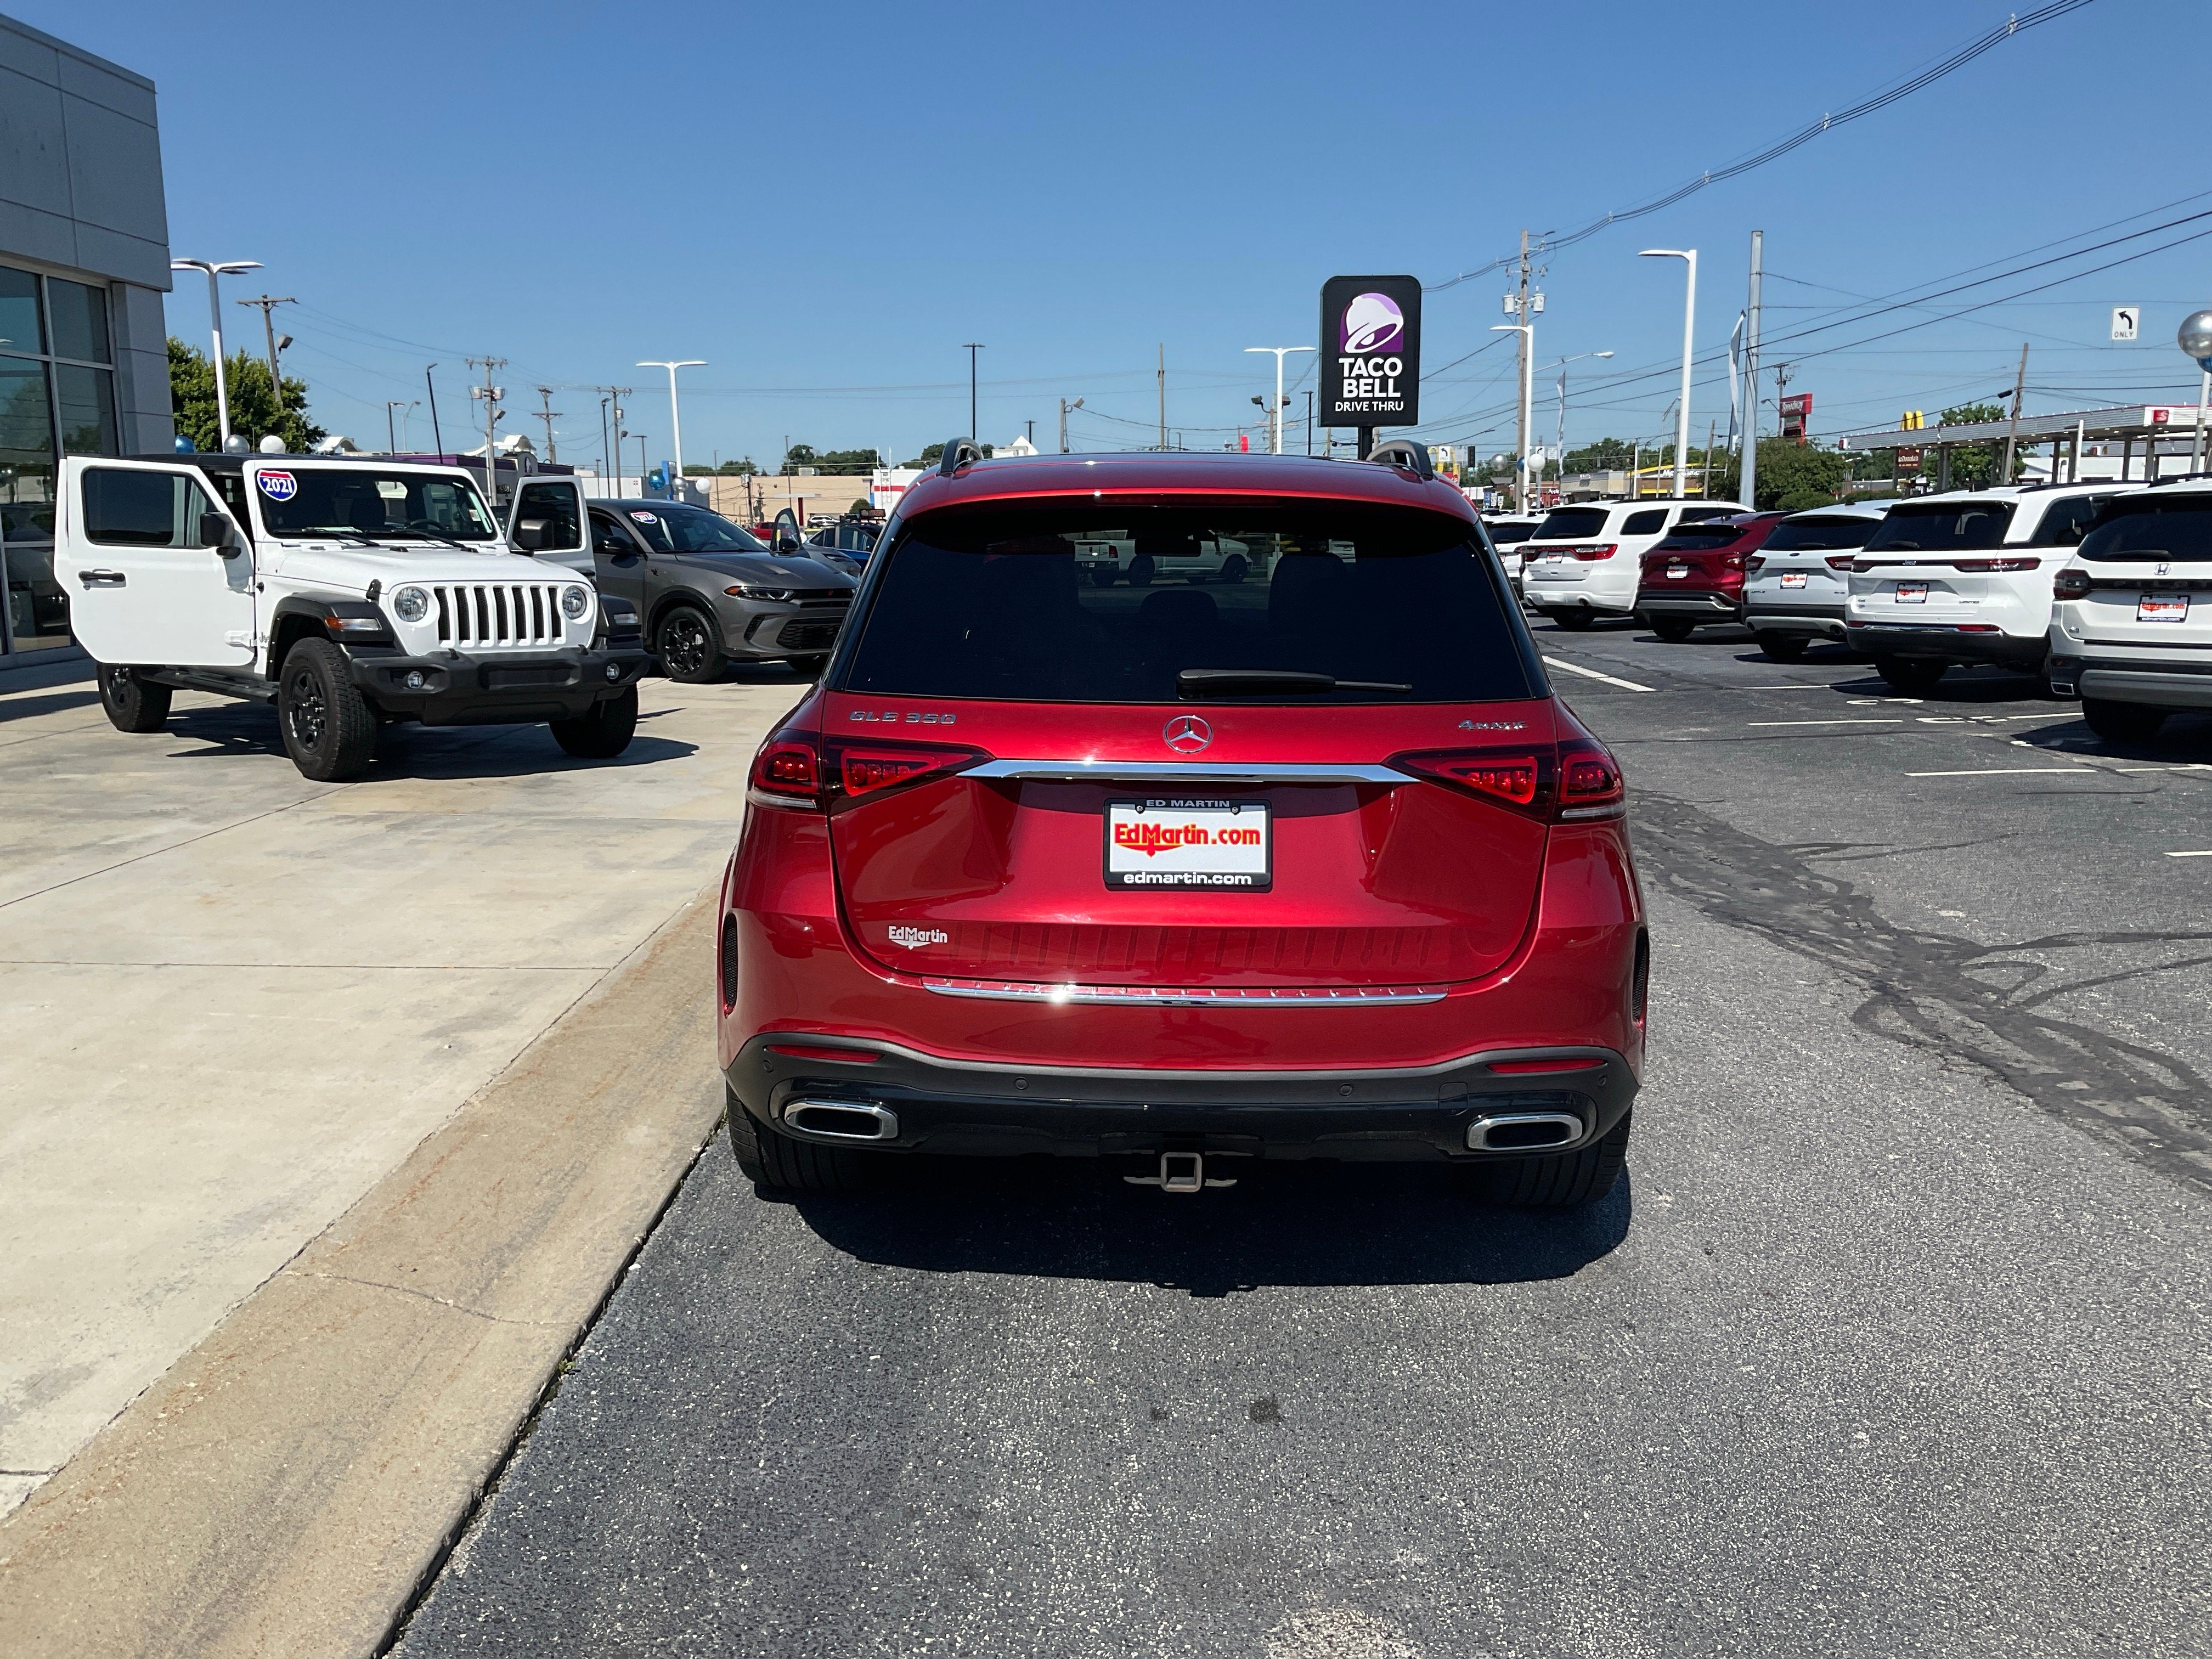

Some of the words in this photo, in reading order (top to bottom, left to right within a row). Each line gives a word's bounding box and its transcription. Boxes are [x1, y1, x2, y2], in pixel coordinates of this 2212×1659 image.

[1339, 358, 1402, 376] TACO
[1343, 379, 1401, 398] BELL
[1335, 402, 1369, 411] DRIVE
[1372, 401, 1403, 410] THRU
[263, 478, 293, 493] 2021
[850, 711, 899, 722] GLE
[905, 713, 957, 724] 350
[1114, 823, 1260, 850] EdMartin.com
[1124, 872, 1251, 884] edmartin.com
[889, 926, 947, 945] EdMartin
